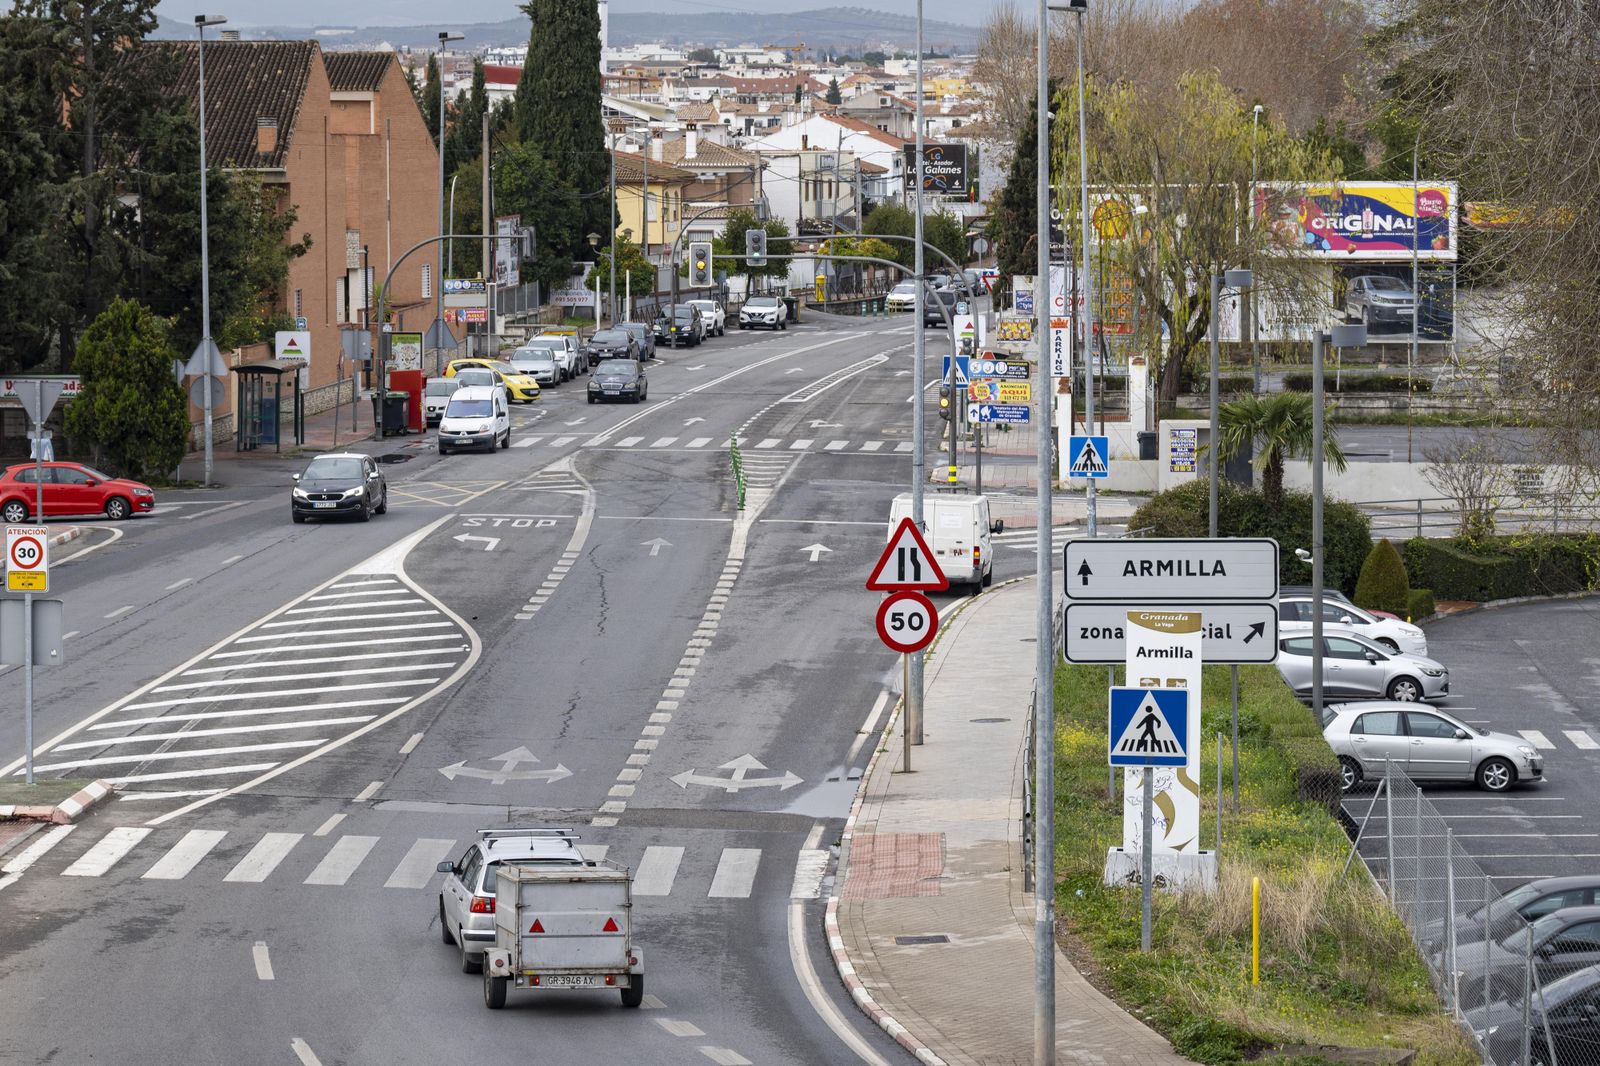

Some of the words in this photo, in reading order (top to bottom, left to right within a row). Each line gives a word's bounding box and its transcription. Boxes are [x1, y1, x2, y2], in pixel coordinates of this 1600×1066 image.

[925, 165, 962, 174] Galanes
[1055, 330, 1063, 371] PARKING
[462, 518, 557, 528] STOP
[18, 548, 35, 558] 30
[1122, 559, 1227, 577] ARMILLA
[891, 612, 924, 631] 50
[1140, 613, 1189, 621] Granada
[1080, 626, 1124, 640] zona
[1136, 646, 1193, 658] Armilla
